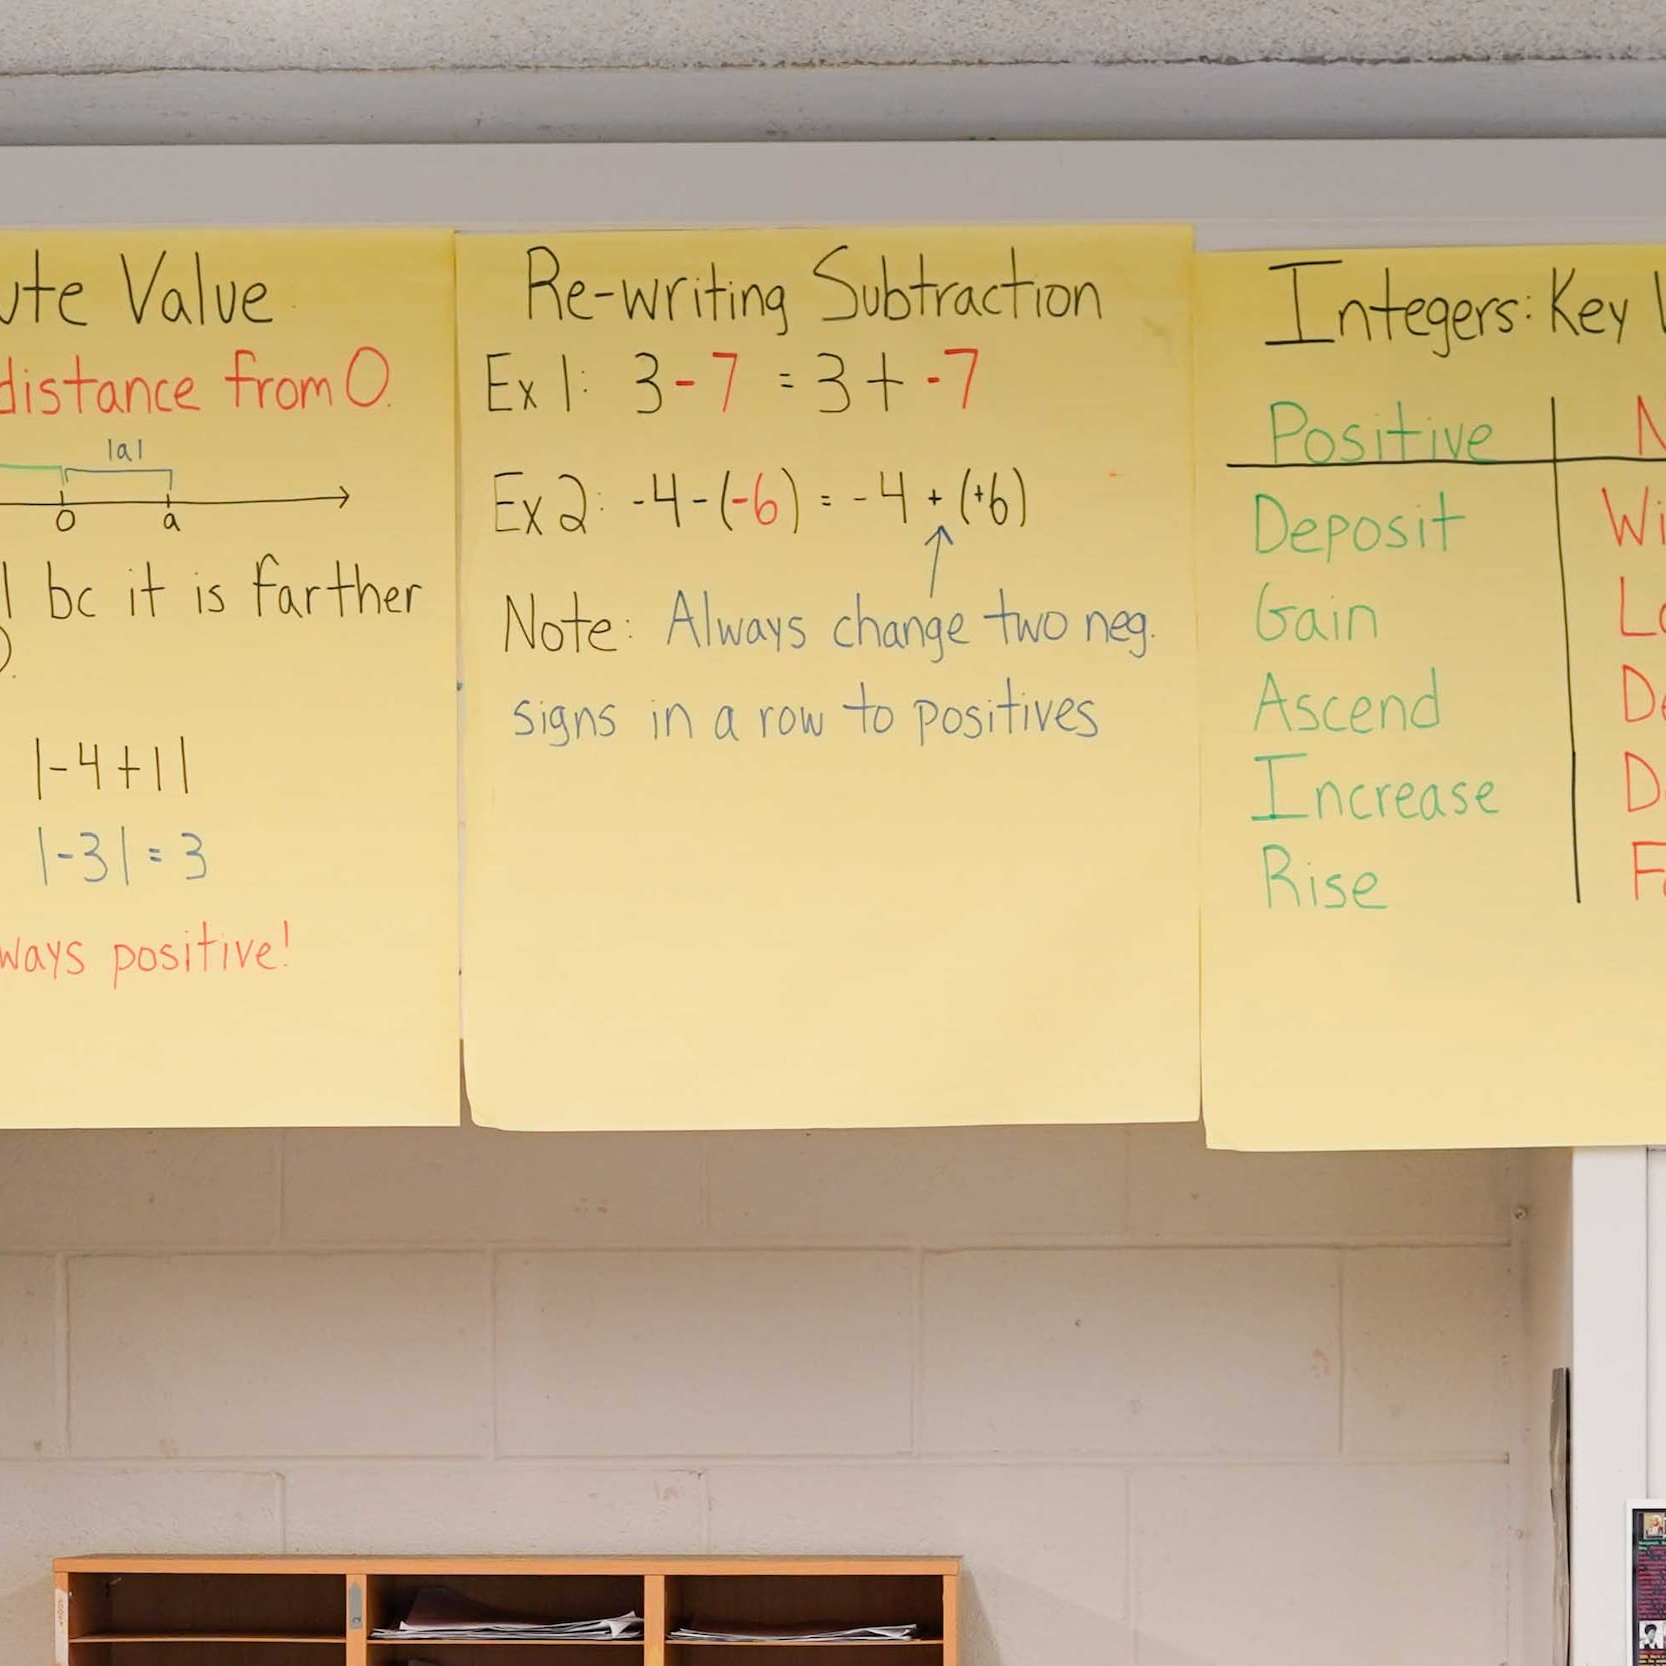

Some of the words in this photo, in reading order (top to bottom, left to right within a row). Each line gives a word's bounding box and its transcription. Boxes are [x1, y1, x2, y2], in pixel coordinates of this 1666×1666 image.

[121, 250, 275, 327] Value
[526, 245, 790, 337] Re-writing
[812, 245, 1104, 322] Subtraction
[1263, 259, 1534, 358] Integers:
[1549, 266, 1630, 344] Key
[224, 349, 333, 412] from
[486, 352, 539, 412] Ex
[1270, 399, 1499, 465] Positive
[492, 471, 544, 535] Ex
[1253, 491, 1467, 563] Deposit
[47, 560, 97, 620] bc
[129, 562, 166, 618] it
[195, 572, 226, 615] is
[252, 553, 423, 619] farther
[1256, 580, 1379, 642] Gain
[666, 589, 809, 650] Always
[832, 592, 972, 664] change
[982, 587, 1069, 643] two
[514, 697, 617, 749] signs
[651, 699, 694, 741] in
[714, 704, 741, 738] a
[758, 701, 825, 738] row
[842, 680, 895, 736] to
[914, 676, 1100, 748] positives
[1253, 665, 1441, 735] Ascend
[1251, 752, 1501, 822] Increase
[1261, 844, 1388, 909] Rise
[113, 918, 291, 992] positive!
